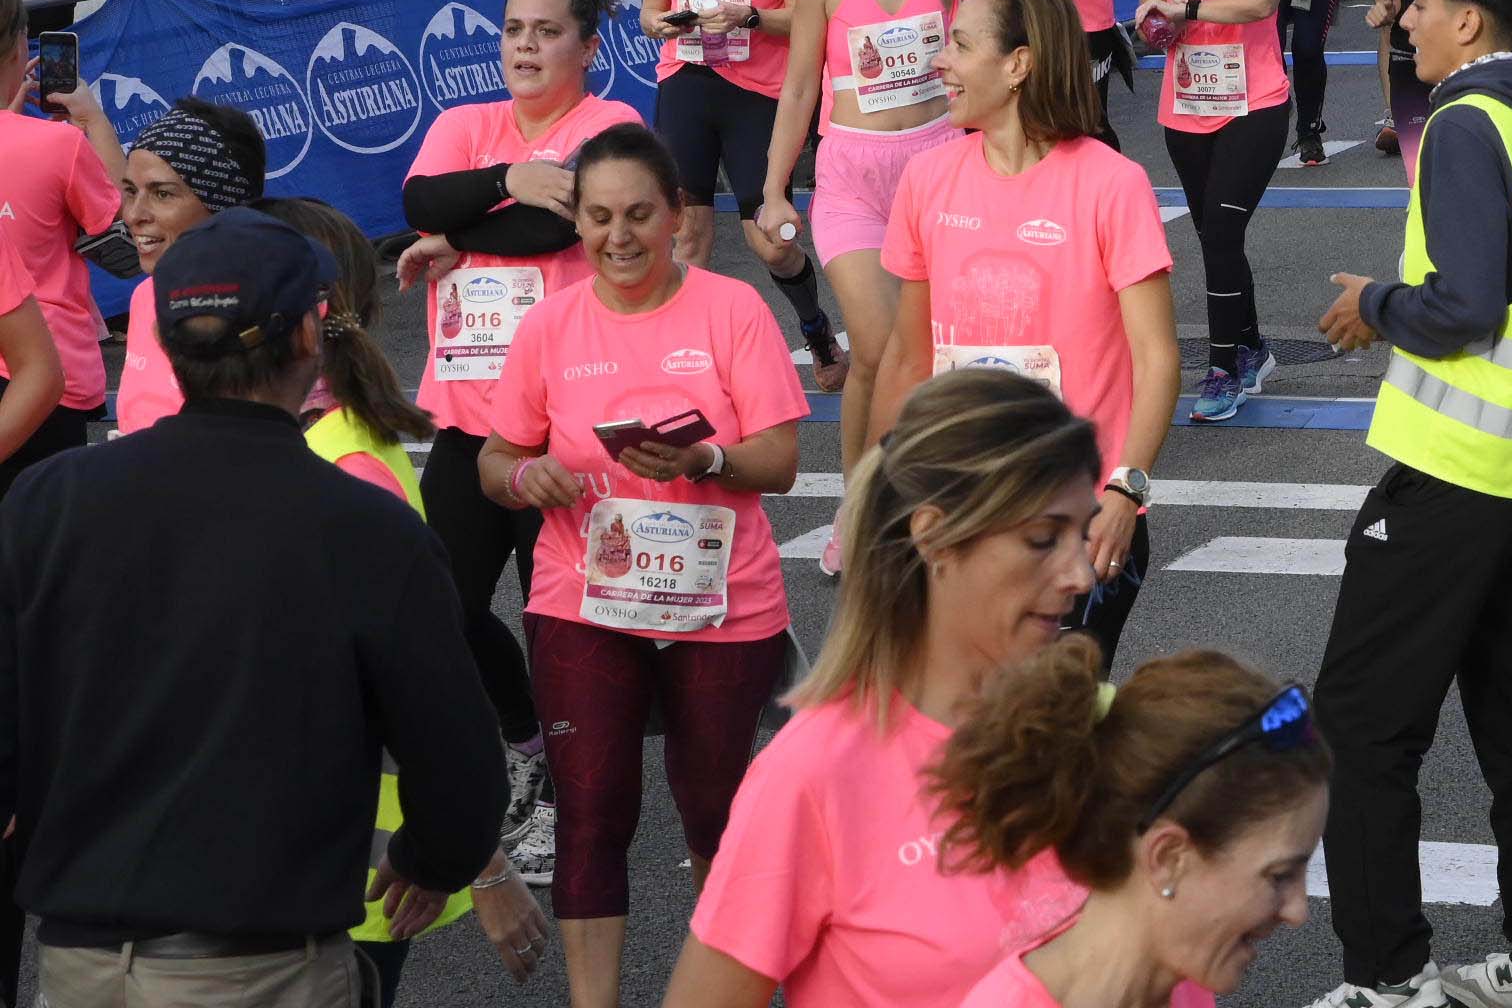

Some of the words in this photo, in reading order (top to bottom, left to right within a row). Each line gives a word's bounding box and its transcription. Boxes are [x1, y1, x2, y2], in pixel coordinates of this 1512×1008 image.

[439, 47, 474, 61] CENTRAL
[475, 41, 501, 56] LECHE
[885, 52, 918, 67] 016
[327, 68, 364, 84] CENTRAL
[366, 61, 402, 78] LECHERA
[429, 54, 507, 101] ASTURIA
[891, 68, 916, 79] 30548
[1193, 73, 1218, 84] 016
[319, 78, 417, 128] ASTURIANA
[868, 95, 897, 105] OYSHO
[464, 287, 503, 298] ASTURIANA
[465, 312, 501, 328] 016
[471, 333, 494, 343] 3604
[440, 363, 470, 373] OYSHO
[563, 361, 618, 381] OYSHO
[636, 520, 690, 537] ASTURIANA
[699, 522, 723, 530] SUMA
[636, 552, 685, 573] 016
[640, 576, 677, 589] 16218
[601, 589, 639, 600] CARRERA
[640, 592, 653, 601] DE
[653, 594, 664, 602] LA
[666, 595, 693, 604] MUJER
[594, 604, 638, 619] OYSHO
